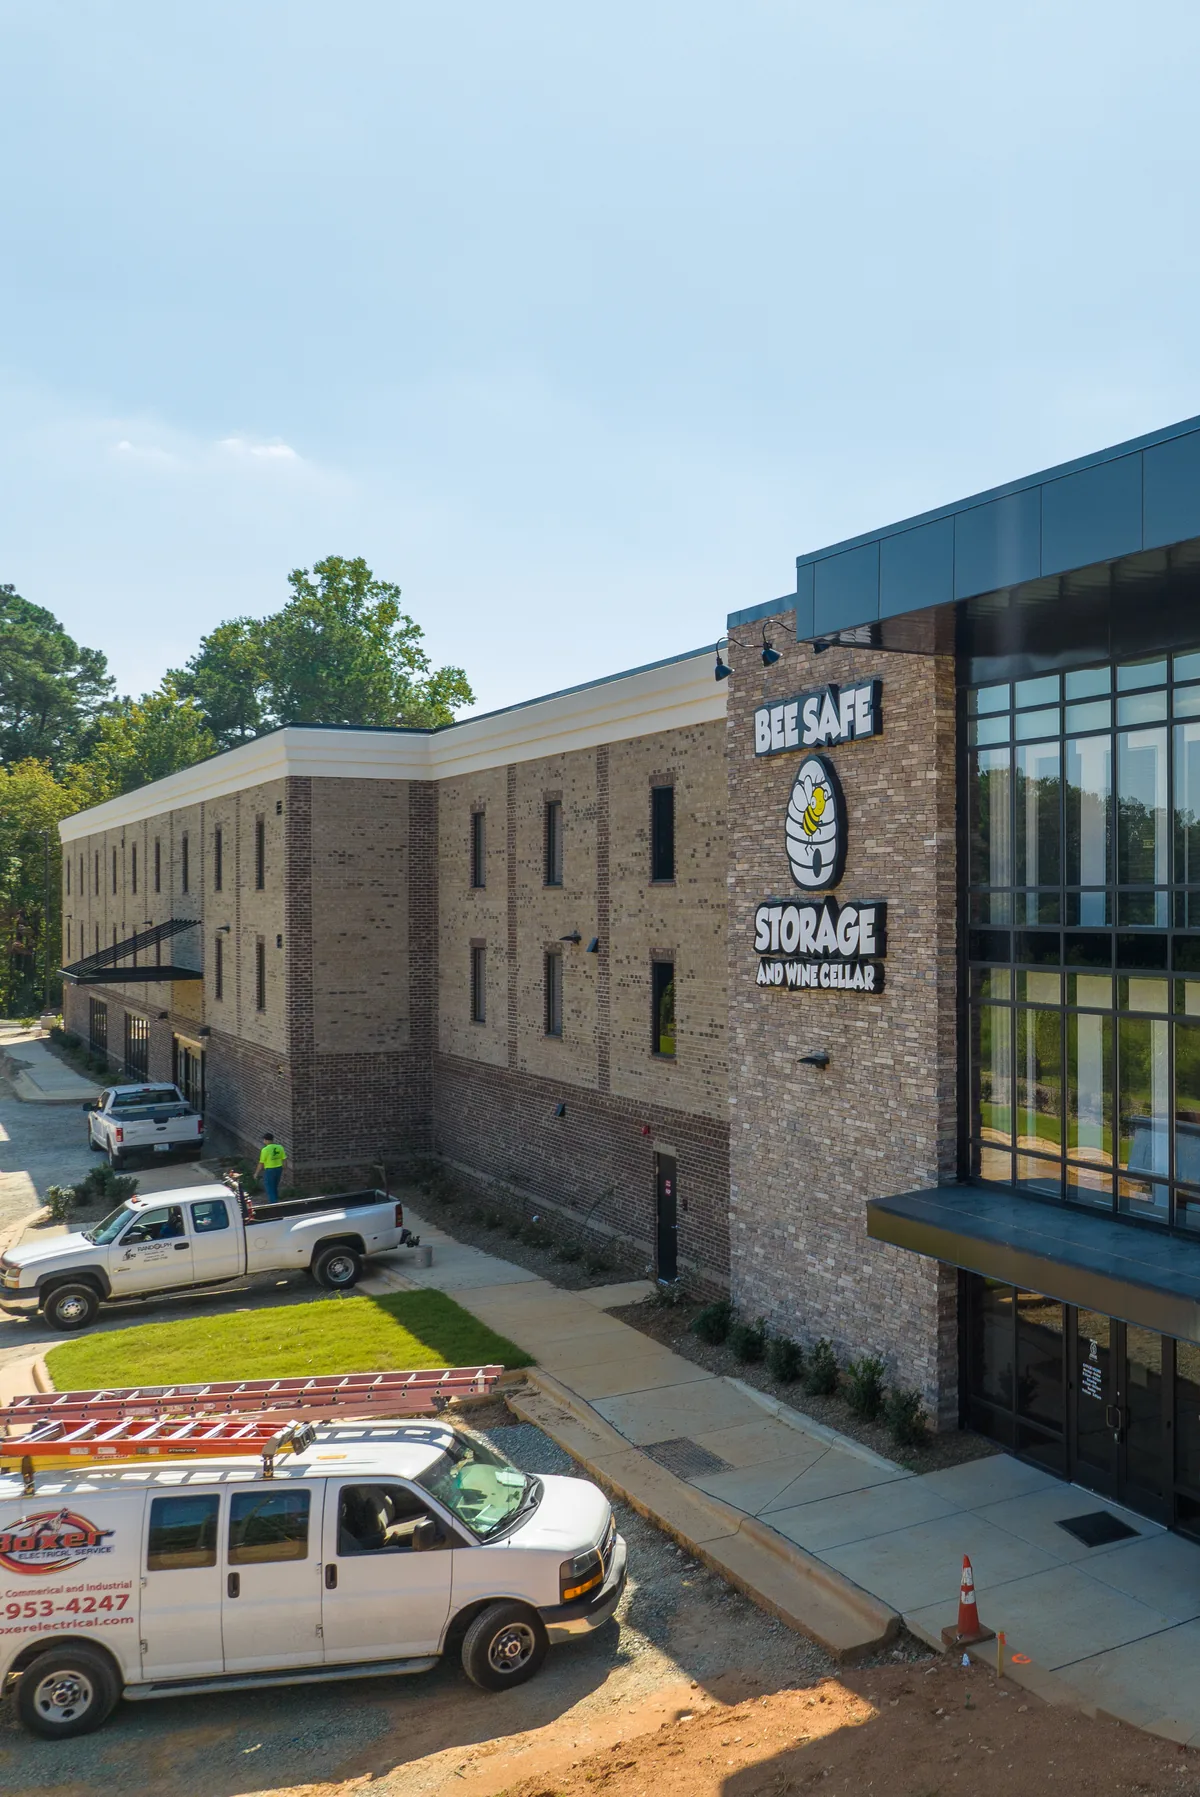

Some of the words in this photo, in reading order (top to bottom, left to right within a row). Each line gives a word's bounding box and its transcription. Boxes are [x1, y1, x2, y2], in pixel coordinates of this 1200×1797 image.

[755, 701, 799, 753] BEE
[802, 685, 872, 745] SAFE
[755, 904, 876, 956] STORAGE
[756, 961, 784, 985] AND
[785, 961, 819, 988] WINE
[820, 962, 875, 991] CELLAR
[18, 1549, 71, 1560] ELECTRICAL
[75, 1546, 112, 1556] SERVICE
[66, 1583, 84, 1593] and
[86, 1580, 133, 1591] Industrial
